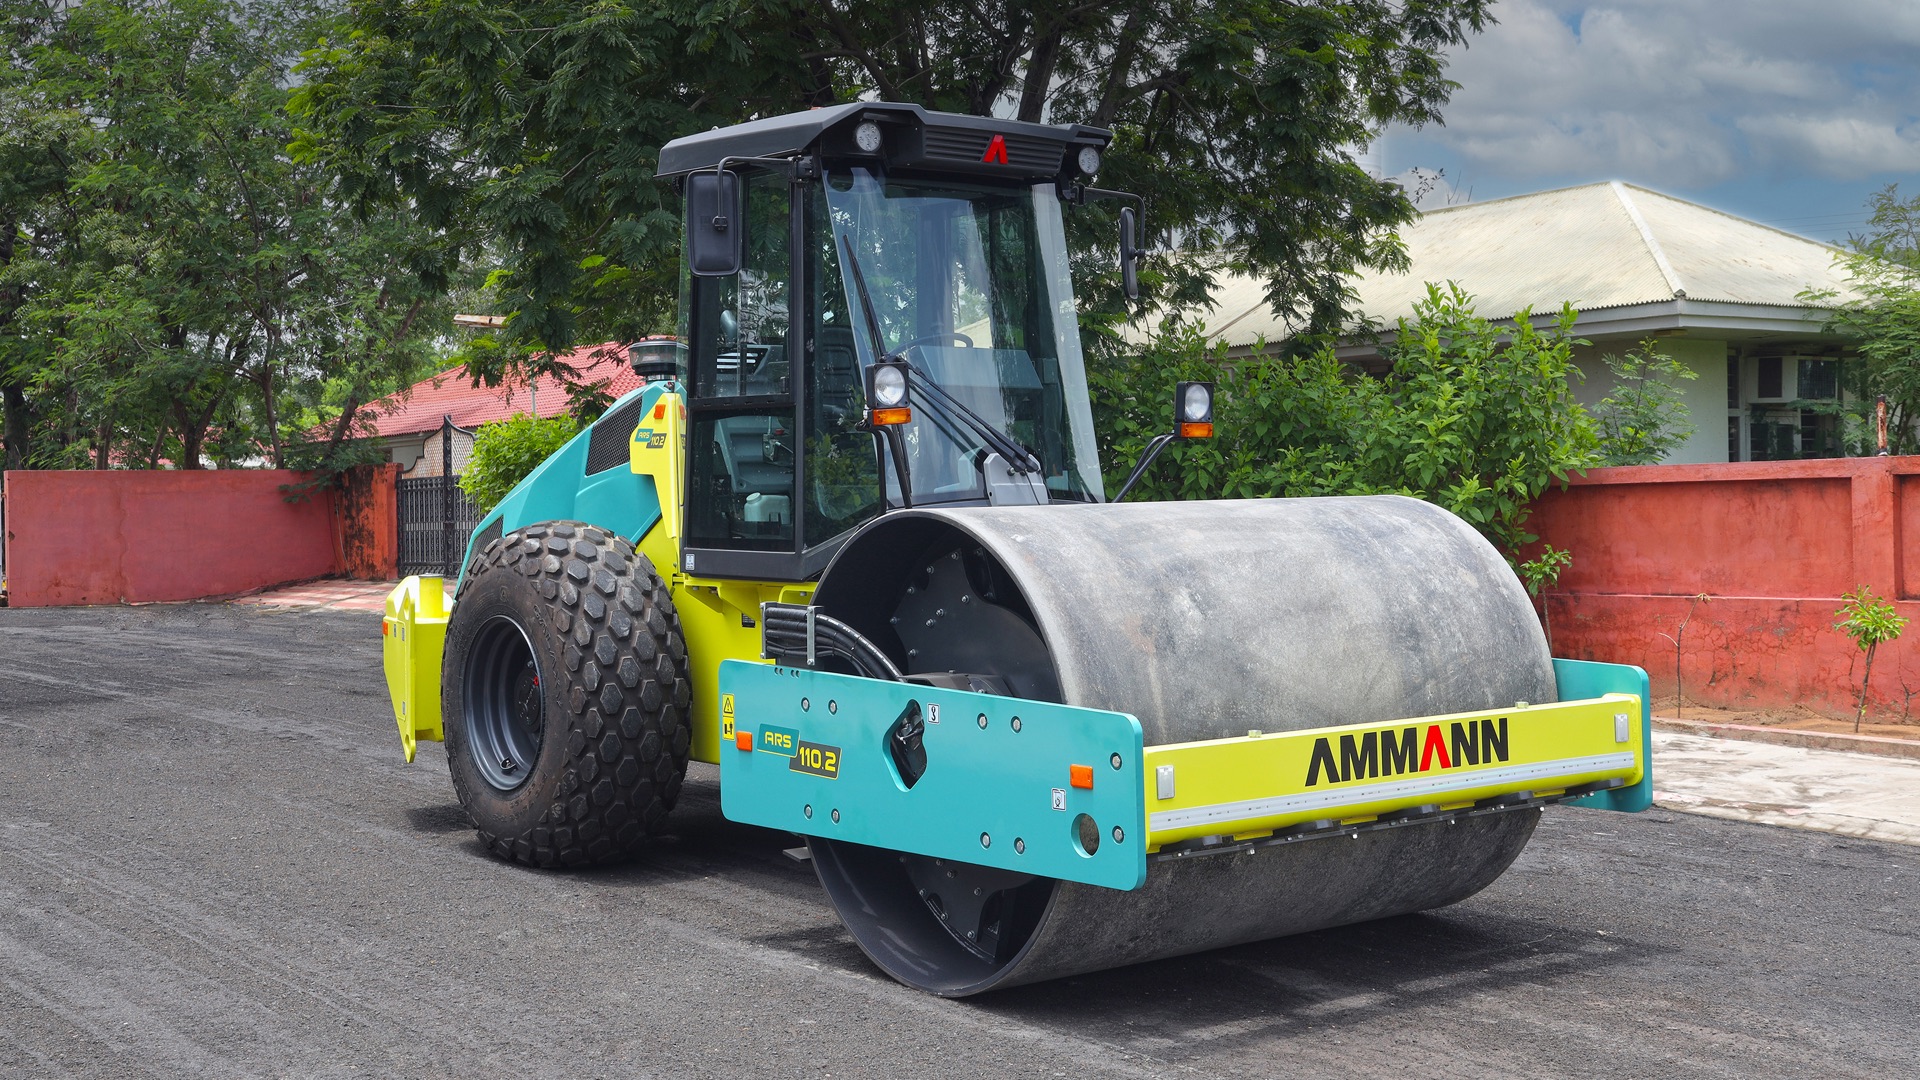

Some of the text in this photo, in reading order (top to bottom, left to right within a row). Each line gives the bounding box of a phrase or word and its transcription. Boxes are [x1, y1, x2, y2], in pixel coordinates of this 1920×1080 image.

[764, 731, 792, 749] ARS
[1305, 718, 1509, 787] AMMANN
[799, 746, 836, 772] 110.2
